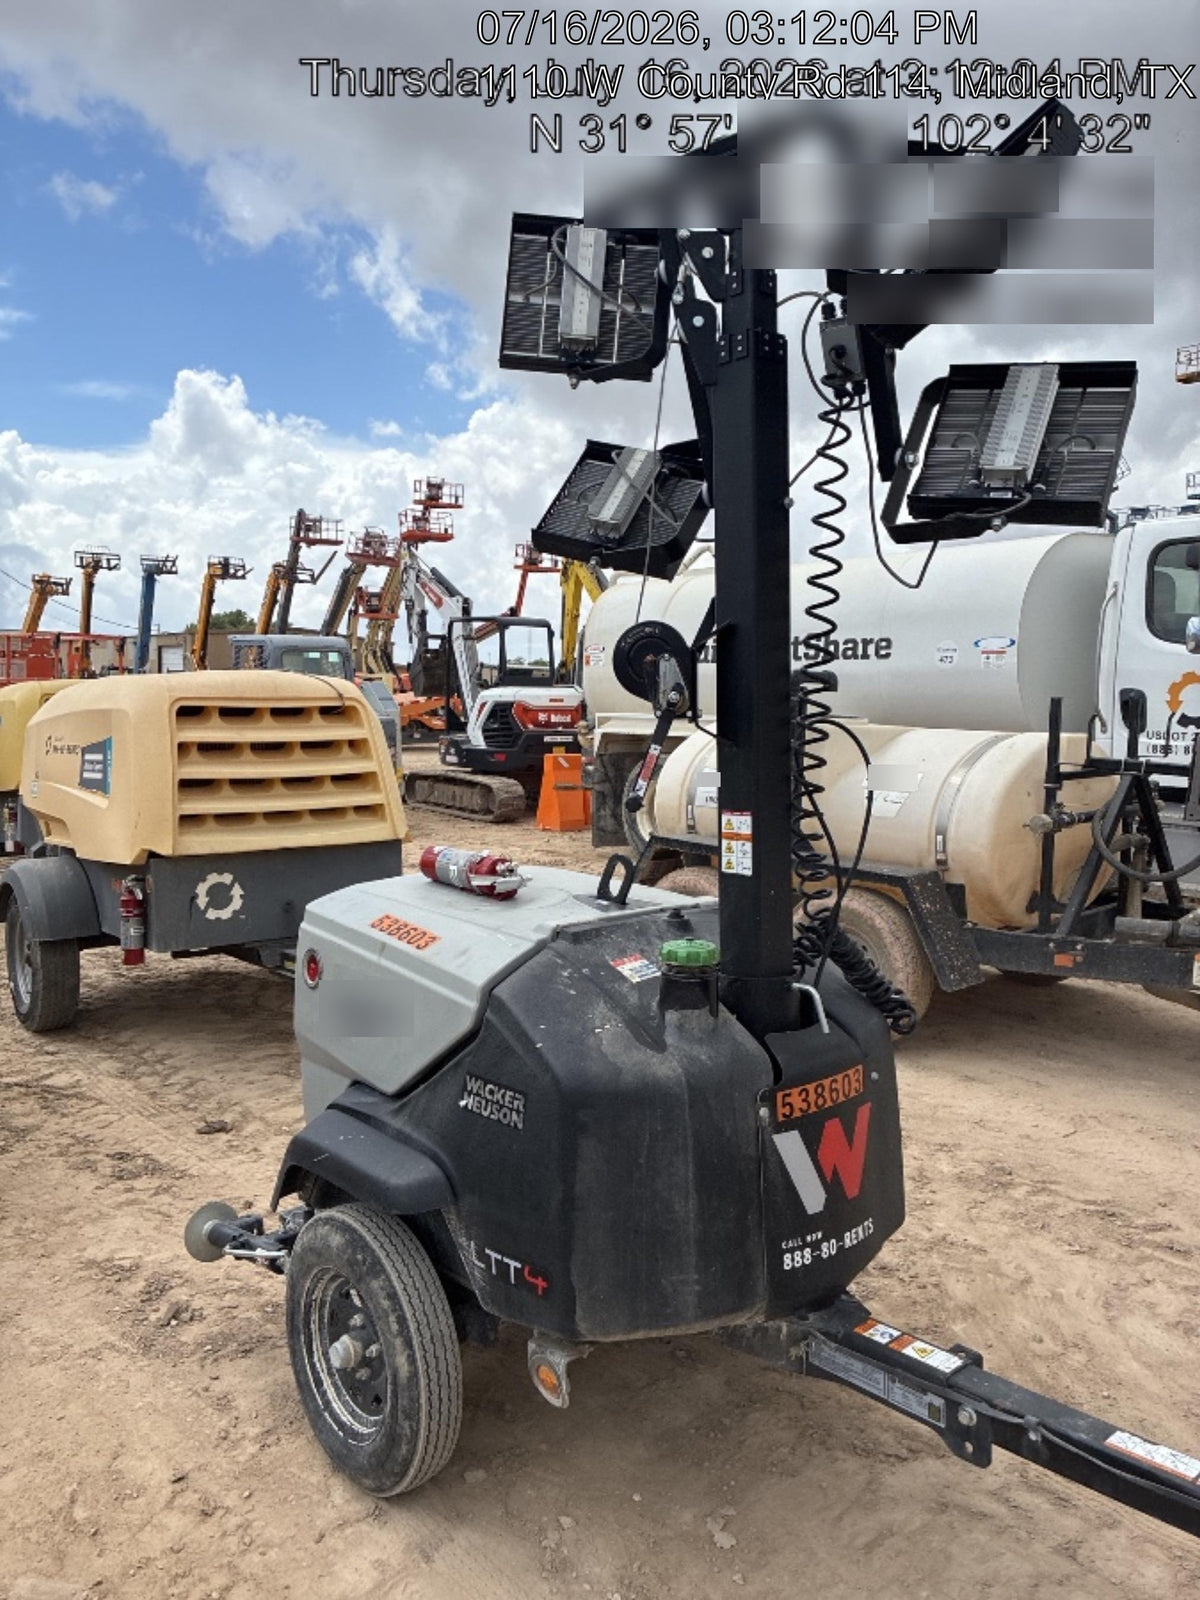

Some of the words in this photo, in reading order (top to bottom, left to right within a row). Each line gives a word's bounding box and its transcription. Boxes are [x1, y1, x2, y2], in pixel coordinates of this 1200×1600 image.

[370, 914, 437, 950] 538603
[466, 1075, 525, 1113] WACKER
[781, 1068, 862, 1120] 538603
